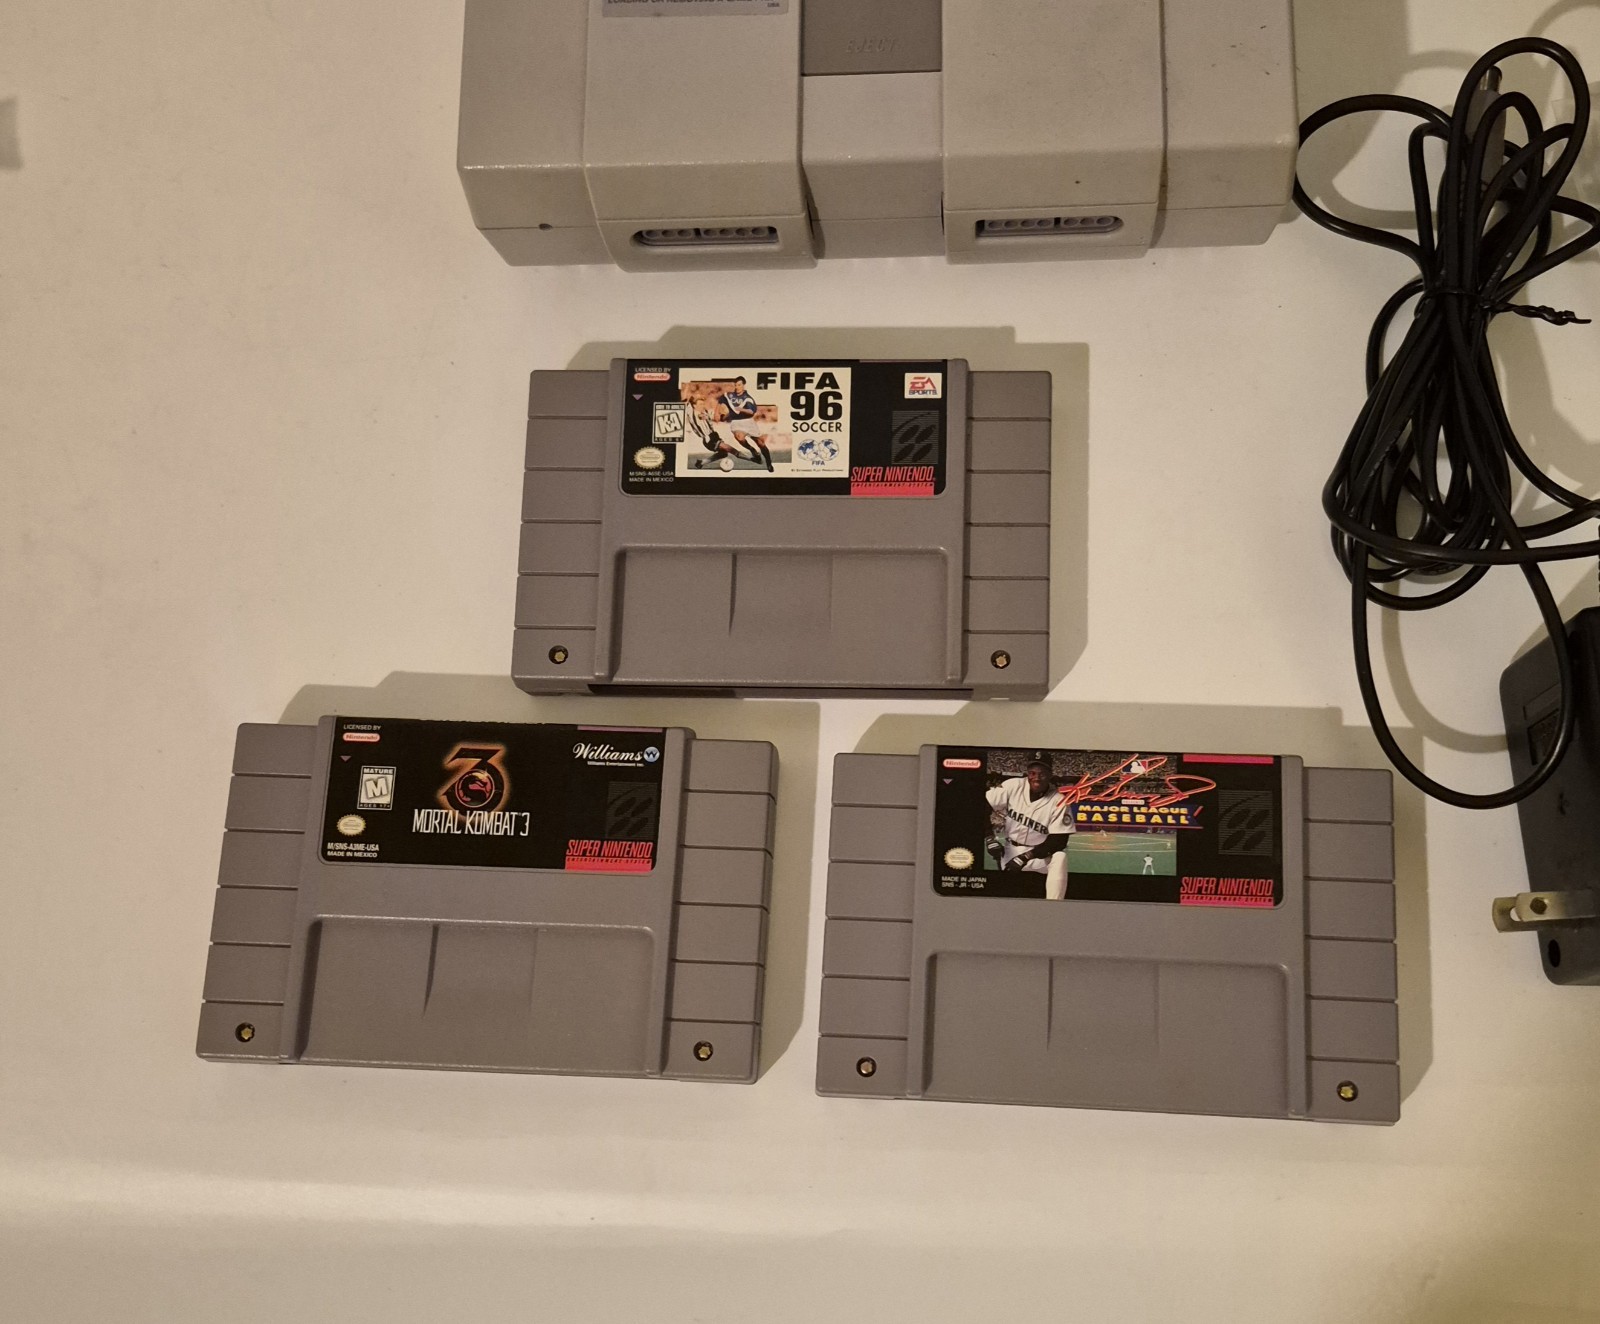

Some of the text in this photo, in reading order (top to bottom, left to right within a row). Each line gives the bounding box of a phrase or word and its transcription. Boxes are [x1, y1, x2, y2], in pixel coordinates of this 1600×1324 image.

[845, 38, 896, 54] EJECT
[757, 372, 840, 390] FIFA
[909, 376, 936, 389] EA
[790, 391, 843, 421] 96
[792, 421, 843, 433] SOCCER
[851, 466, 935, 482] SUPER NINTENDO
[573, 742, 643, 761] Williams
[365, 777, 388, 799] M
[1076, 812, 1189, 825] BASEBALL
[1078, 805, 1188, 815] MAJOR LEAGUE
[412, 808, 530, 836] MORTAL KOMBAT 3
[566, 840, 653, 858] SUPER NINTENDO
[1181, 877, 1274, 896] SUPER NINTENDO
